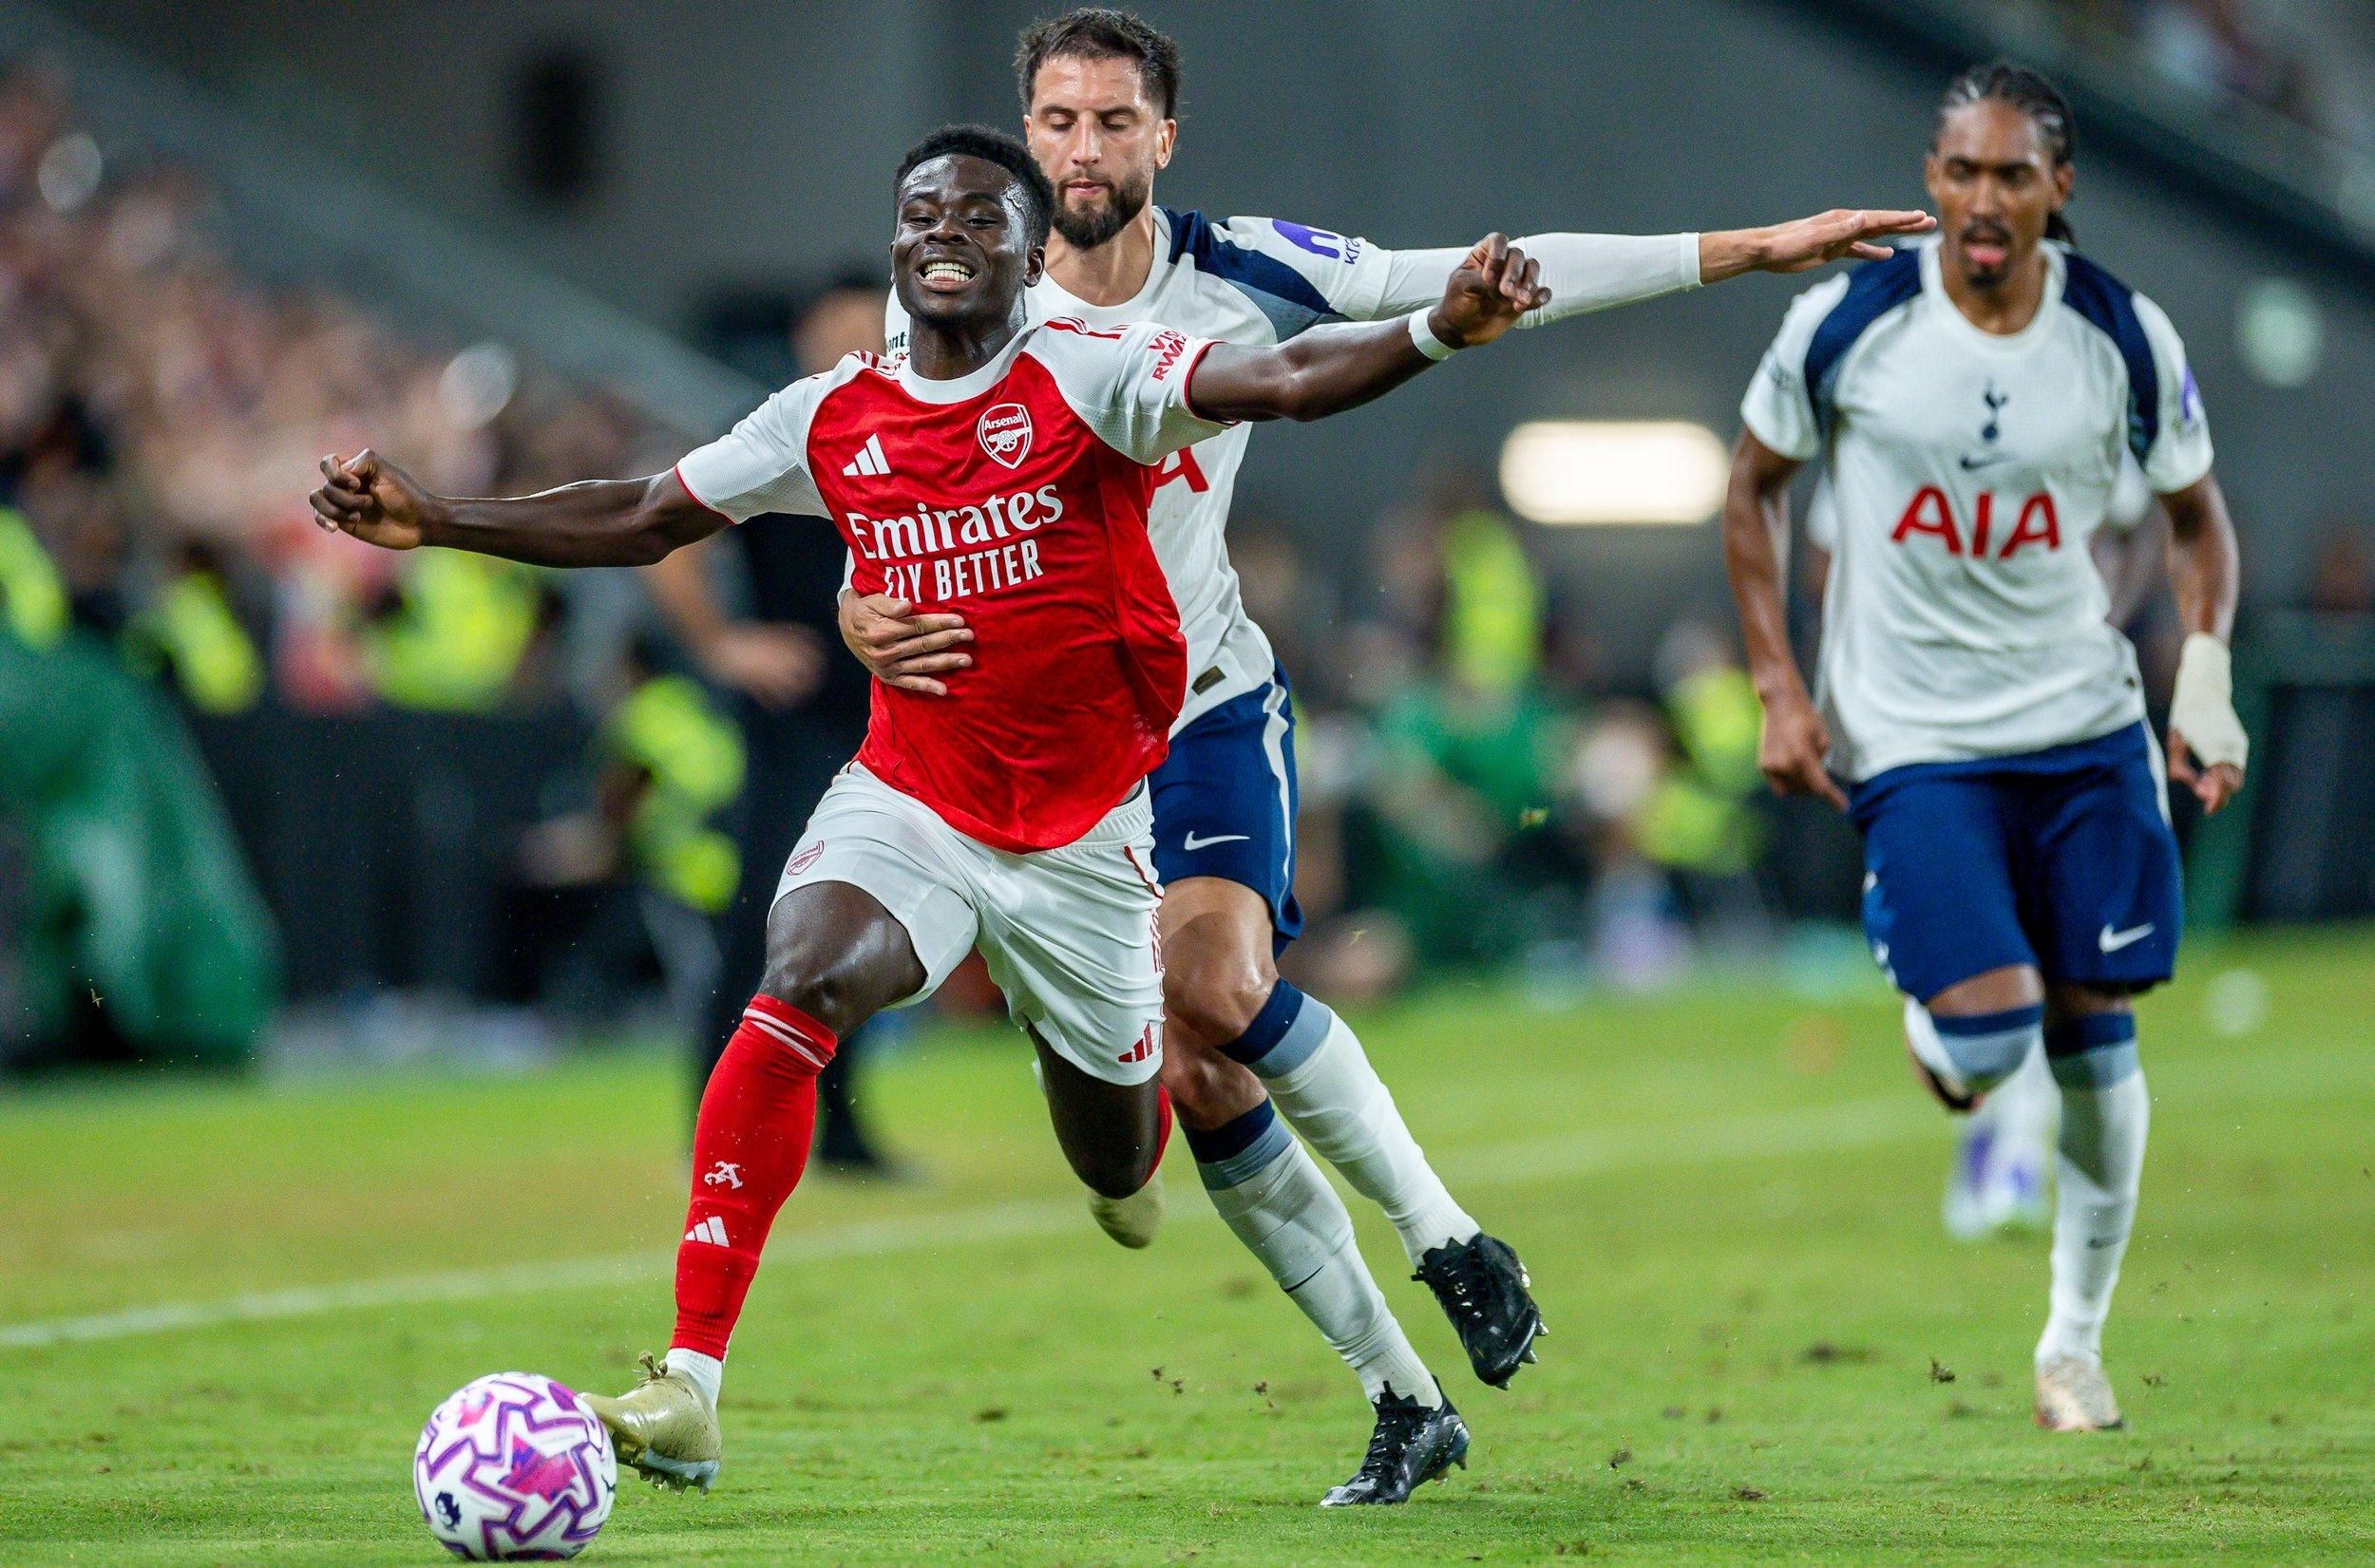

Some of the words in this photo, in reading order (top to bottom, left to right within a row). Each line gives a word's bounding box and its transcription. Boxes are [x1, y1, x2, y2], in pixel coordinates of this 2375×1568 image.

[1148, 330, 1180, 349] VIS
[984, 412, 1023, 431] Arsenal
[846, 484, 1064, 560] Emirates
[1890, 485, 2062, 559] AIA
[884, 562, 922, 604] FLY
[934, 538, 1044, 602] BETTER
